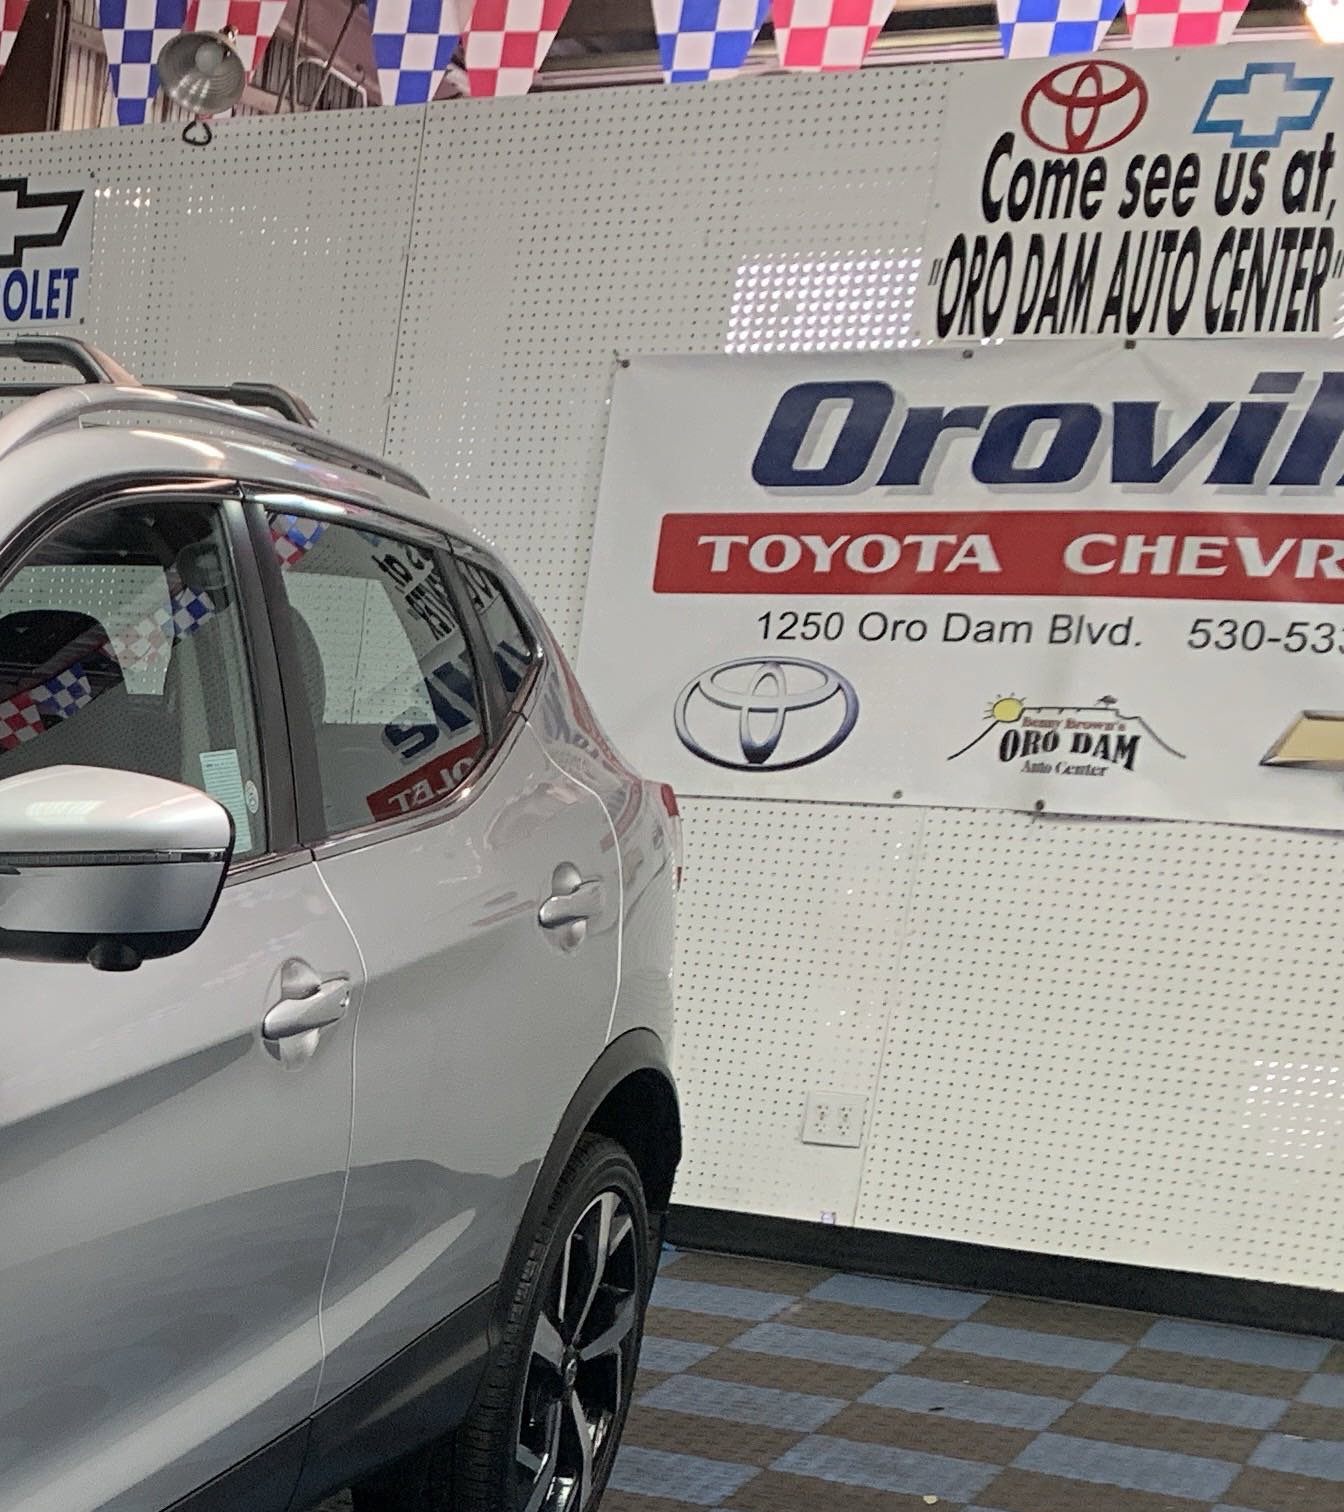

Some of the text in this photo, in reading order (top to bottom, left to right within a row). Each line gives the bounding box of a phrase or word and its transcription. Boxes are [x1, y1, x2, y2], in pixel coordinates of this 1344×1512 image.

[981, 131, 1337, 223] Come see us at,
[928, 226, 1343, 338] "ORO DAM AUTO CENTER"
[750, 371, 1344, 488] Orovil
[697, 533, 1003, 574] TOYOTA
[756, 611, 1344, 654] 1250 Oro Dam Blvd. 530-53
[998, 729, 1142, 772] ORO DAM
[1020, 760, 1109, 777] Auto Center
